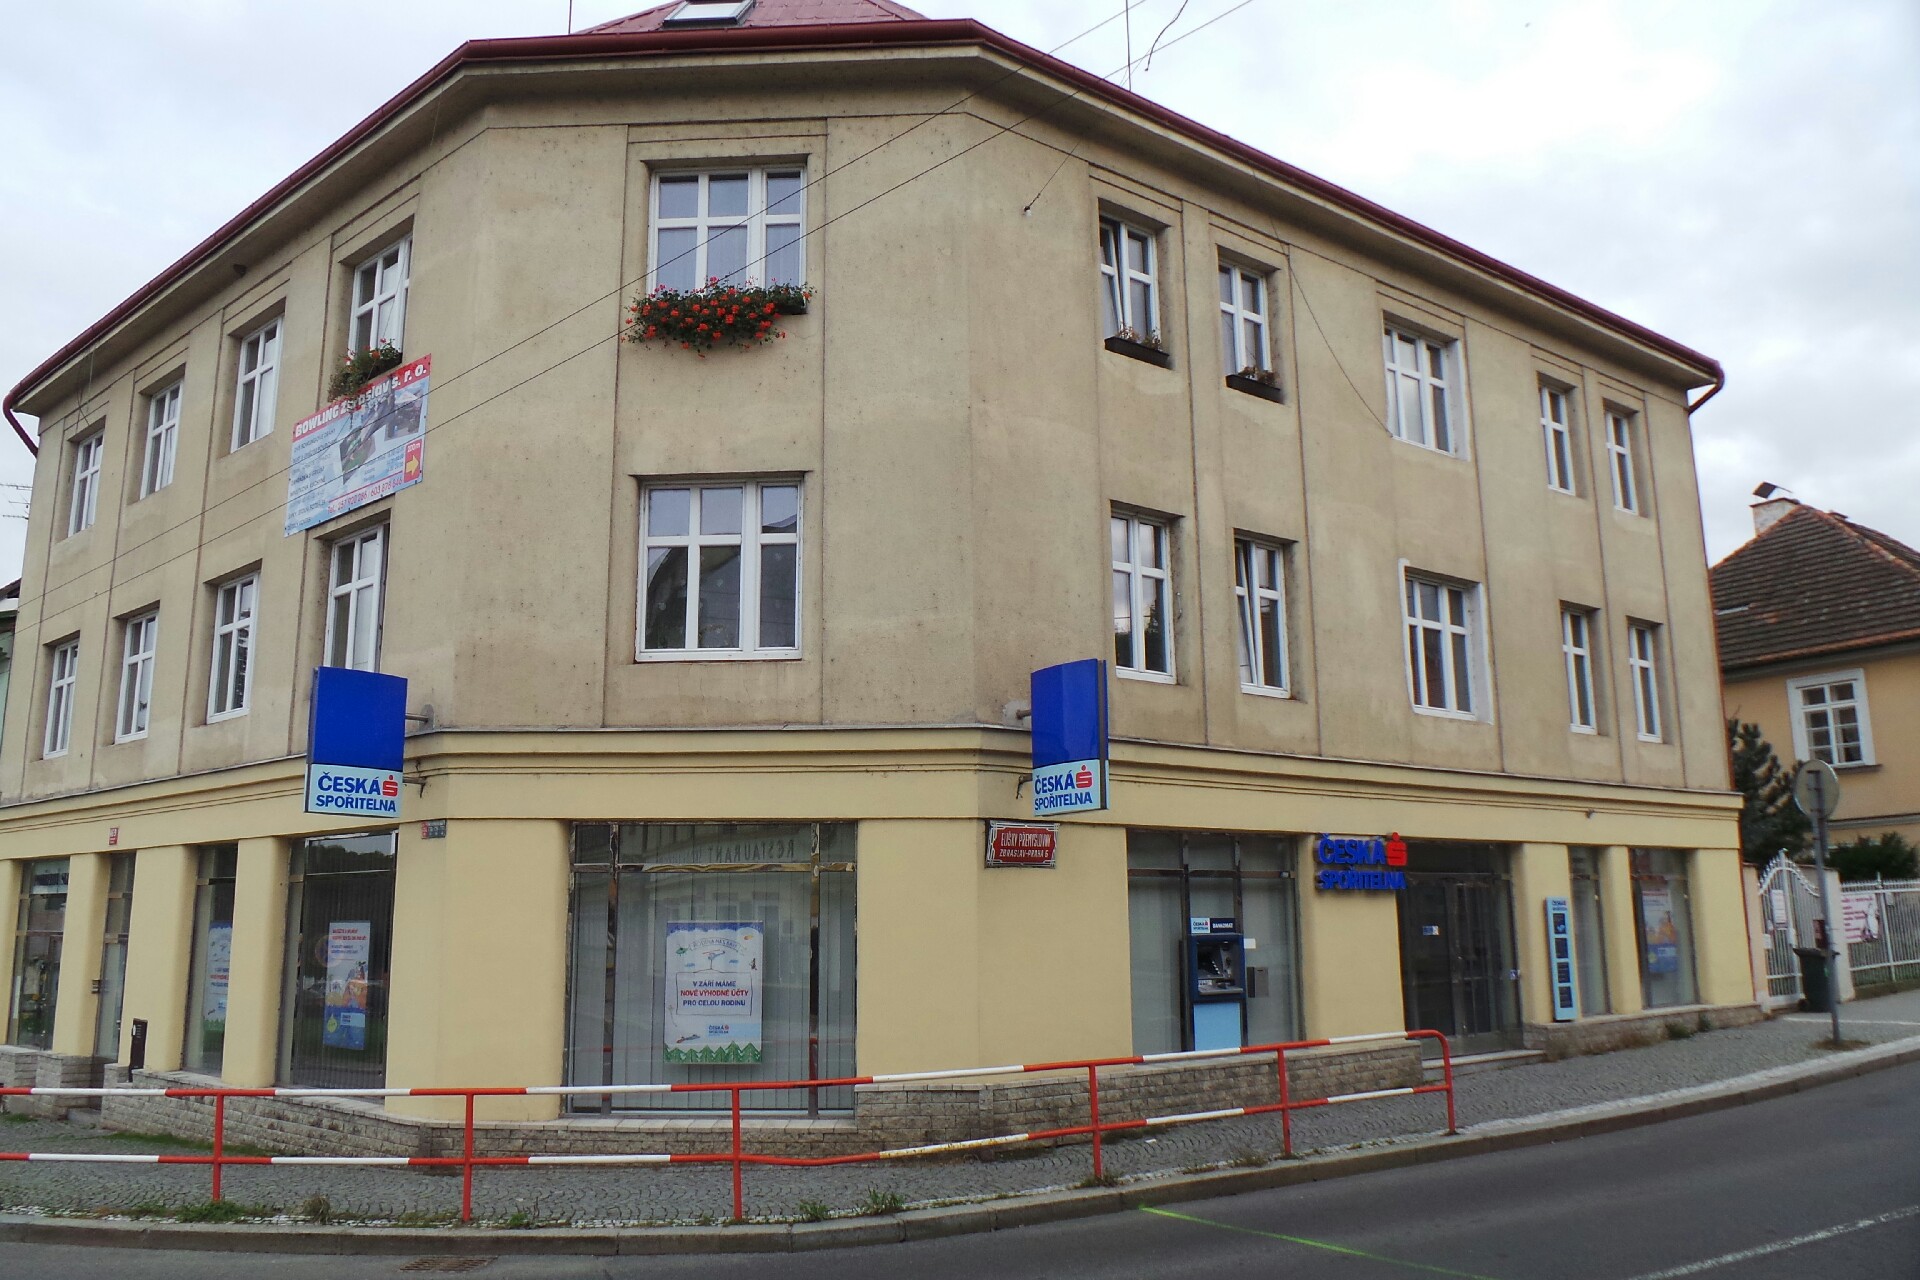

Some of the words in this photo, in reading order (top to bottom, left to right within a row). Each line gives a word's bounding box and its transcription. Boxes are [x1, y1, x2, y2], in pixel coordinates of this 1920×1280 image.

[295, 405, 339, 438] BOWLING
[403, 370, 412, 382] r.
[414, 364, 427, 377] o.
[317, 771, 381, 796] ČESKÁ
[1034, 770, 1075, 795] ČESKÁ
[315, 794, 397, 812] SPOŘITELNA
[1034, 792, 1093, 811] SPOŘITELNA
[1001, 831, 1018, 847] ELIŠKY
[1319, 833, 1386, 865] ČESKÁ
[1319, 866, 1406, 890] SPOŘITELNA
[680, 989, 698, 997] NOVÉ
[699, 988, 730, 997] VÝHODNÉ
[731, 988, 749, 997] ÚČTY
[698, 979, 714, 987] ZÁŘÍ
[715, 979, 737, 987] MÁME
